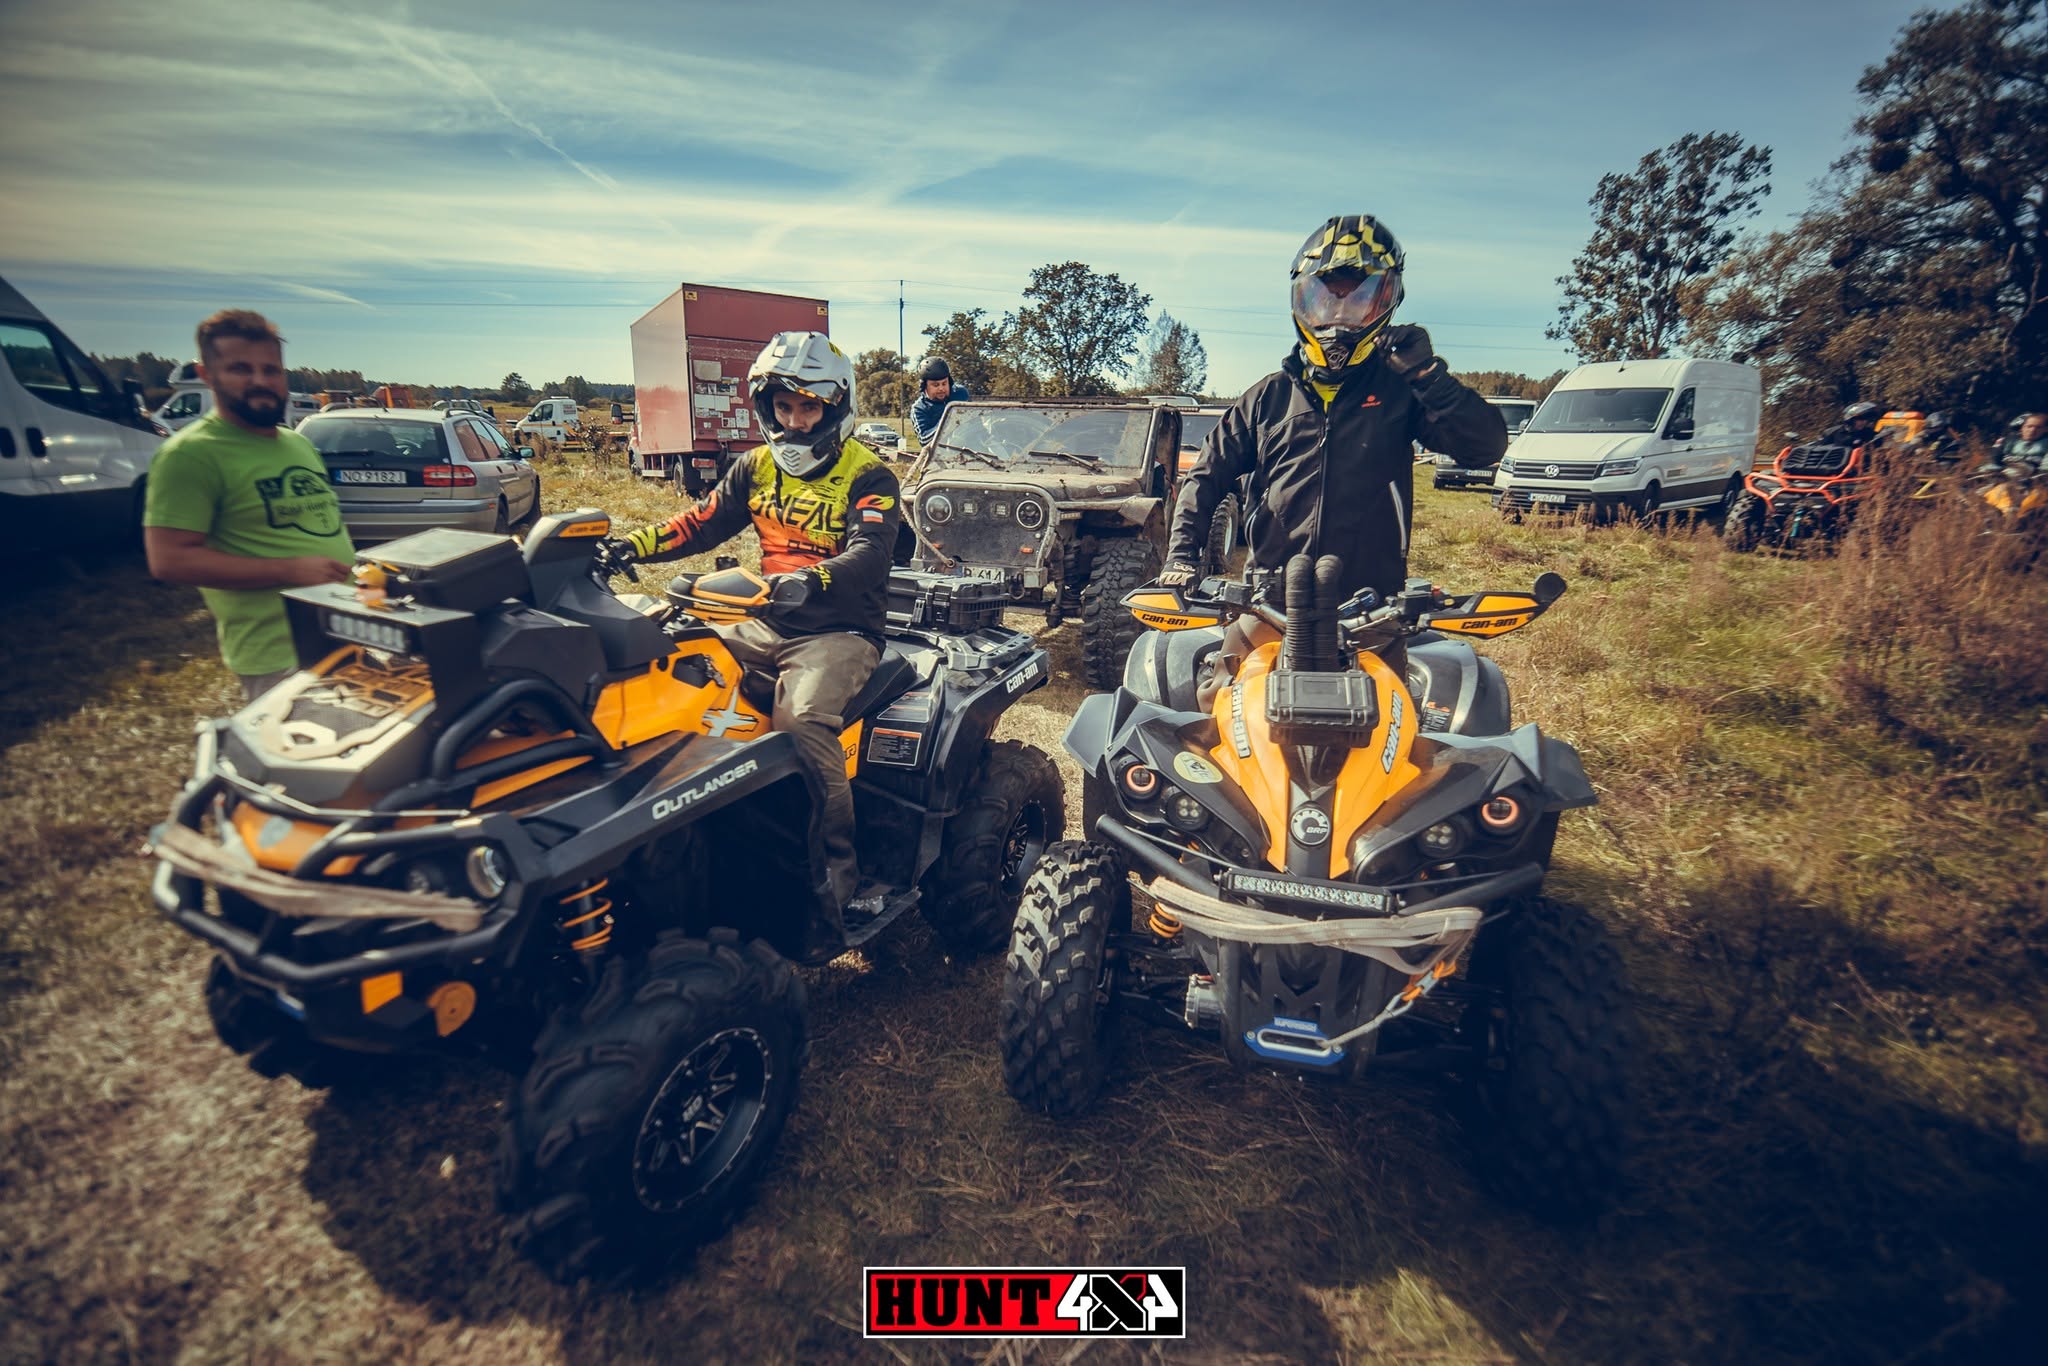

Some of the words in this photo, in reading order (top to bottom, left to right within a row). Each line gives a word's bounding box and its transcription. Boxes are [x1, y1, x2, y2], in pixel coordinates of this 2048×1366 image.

[1142, 613, 1189, 626] can-am
[1461, 617, 1518, 629] can-am
[1006, 661, 1039, 694] can-am
[1232, 683, 1252, 758] can-am
[1381, 690, 1403, 774] can-am
[652, 759, 758, 820] OUTLANDER
